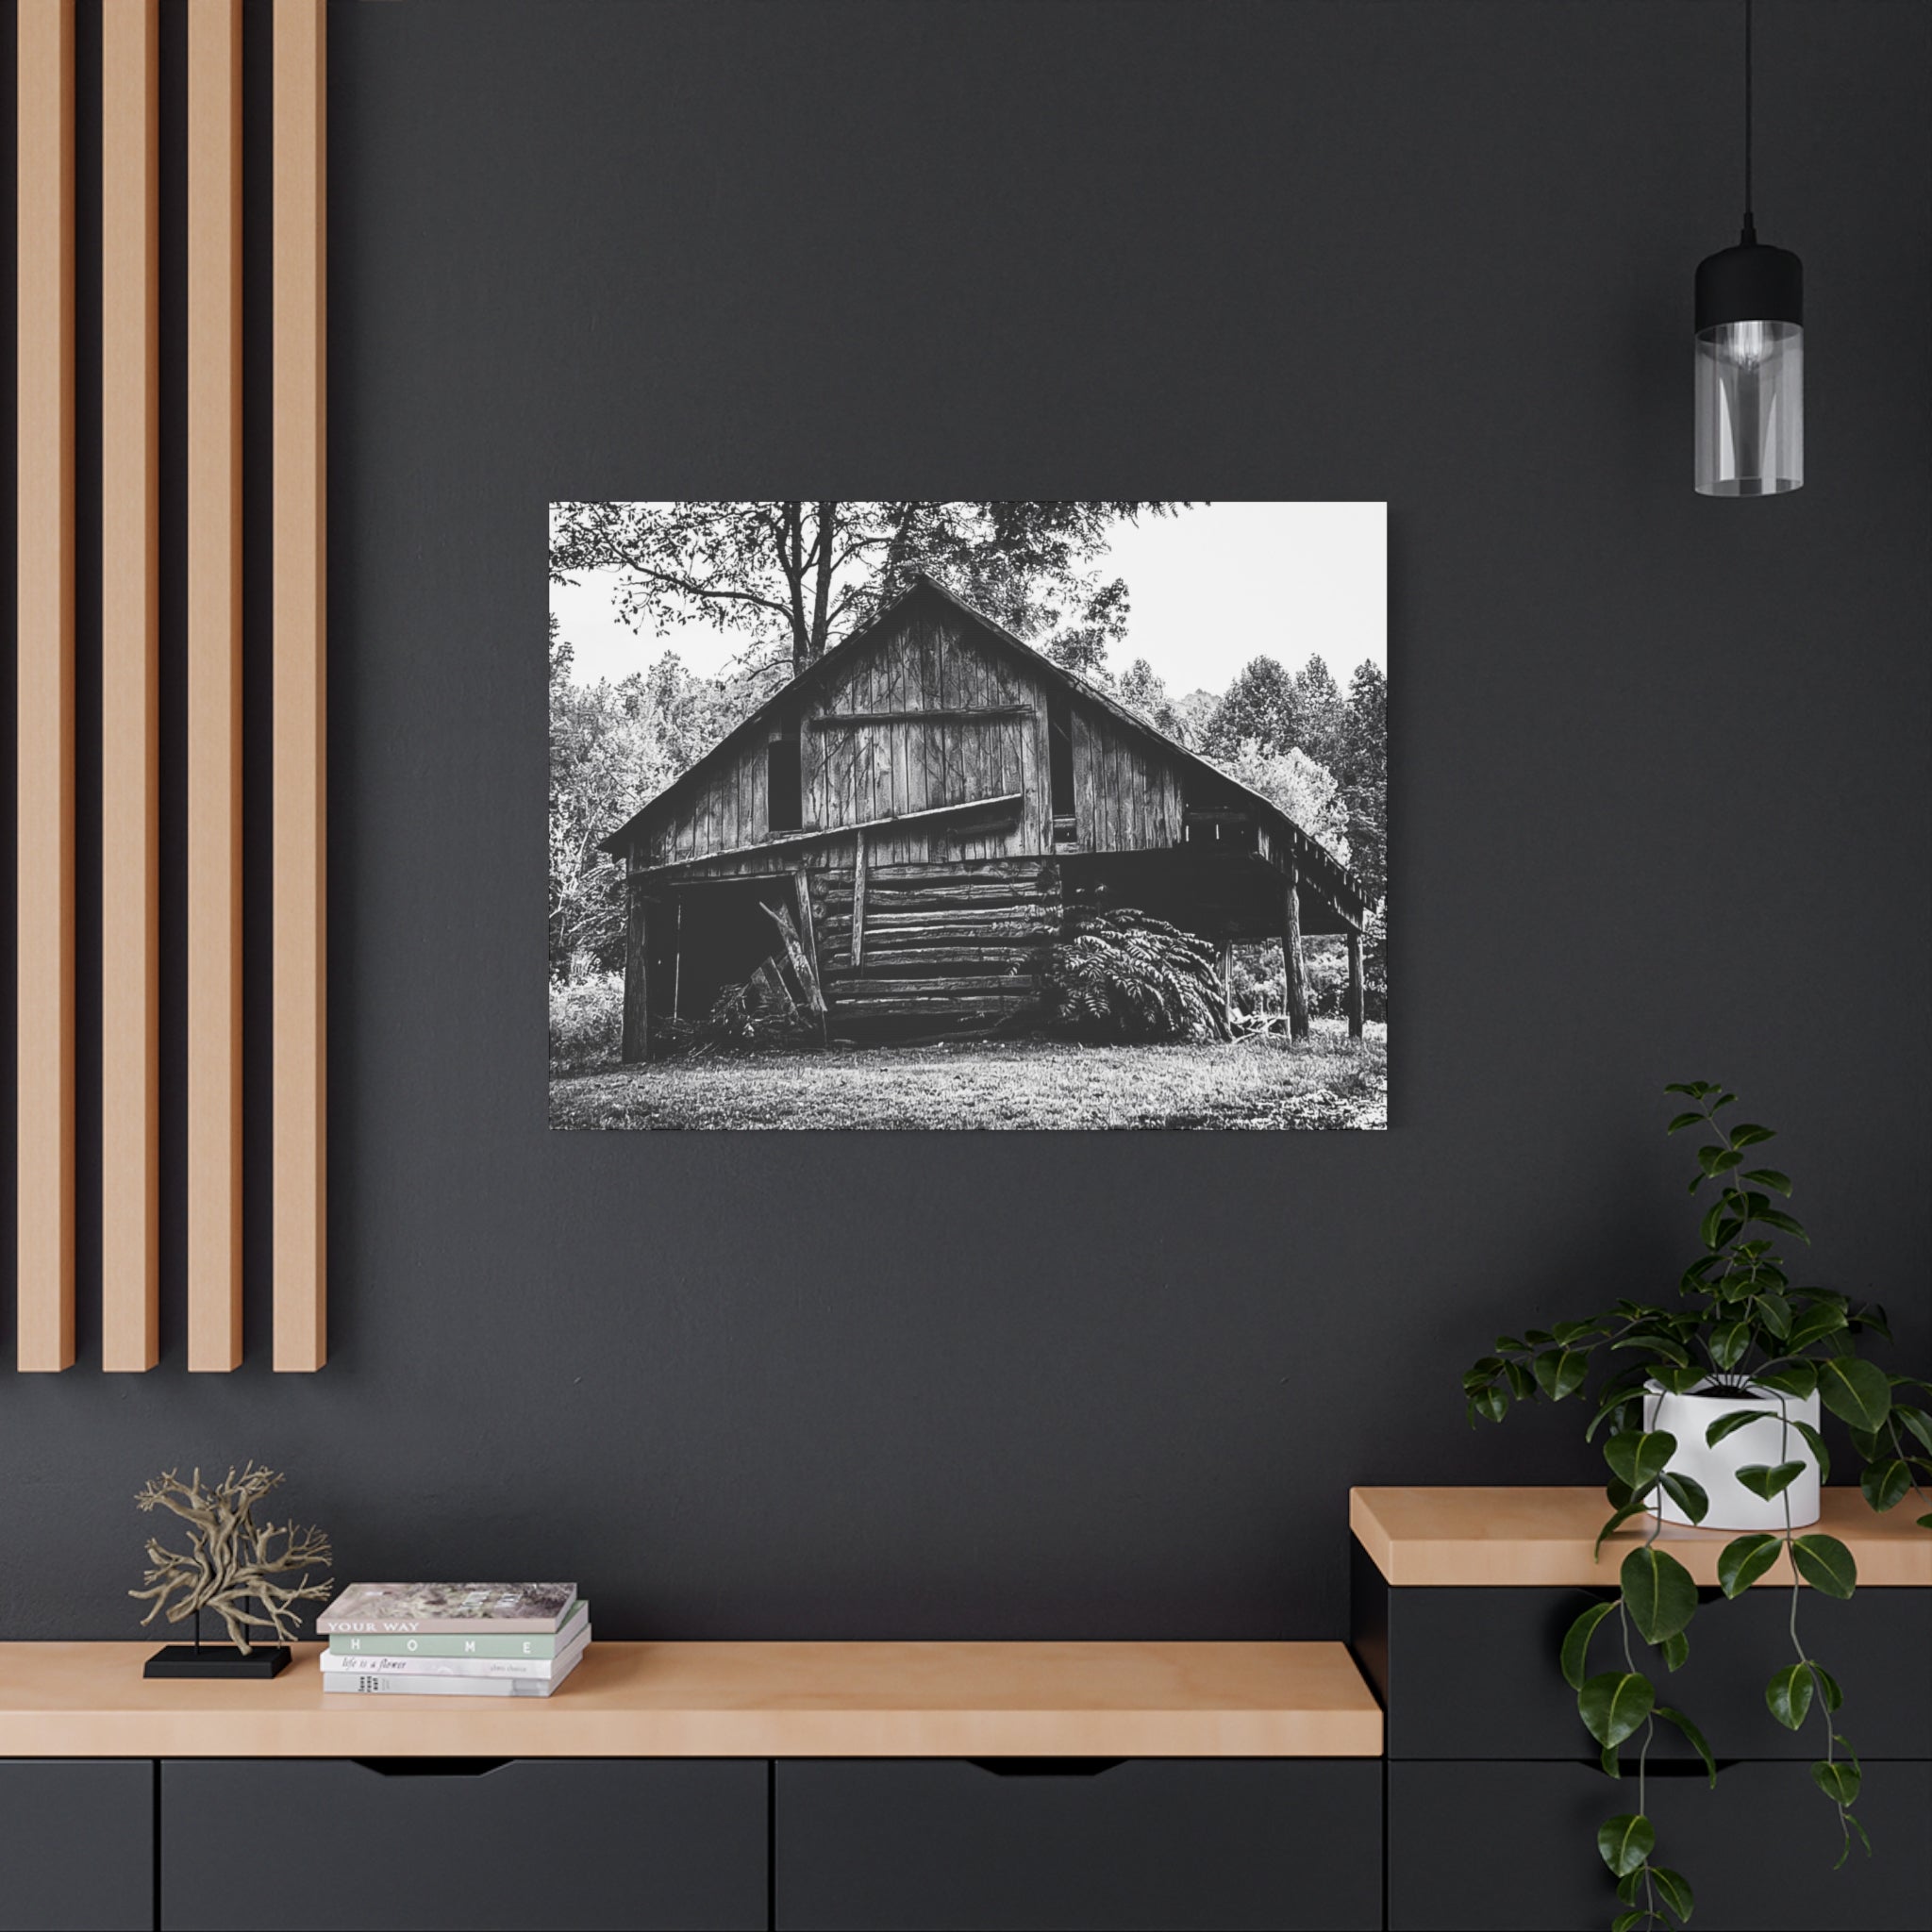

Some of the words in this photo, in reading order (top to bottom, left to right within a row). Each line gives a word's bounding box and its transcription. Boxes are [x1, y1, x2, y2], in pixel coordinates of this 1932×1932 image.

[328, 1622, 376, 1631] YOUR
[382, 1622, 420, 1631] WAY
[350, 1639, 531, 1654] HOME
[341, 1657, 357, 1671] life
[378, 1658, 407, 1672] flower
